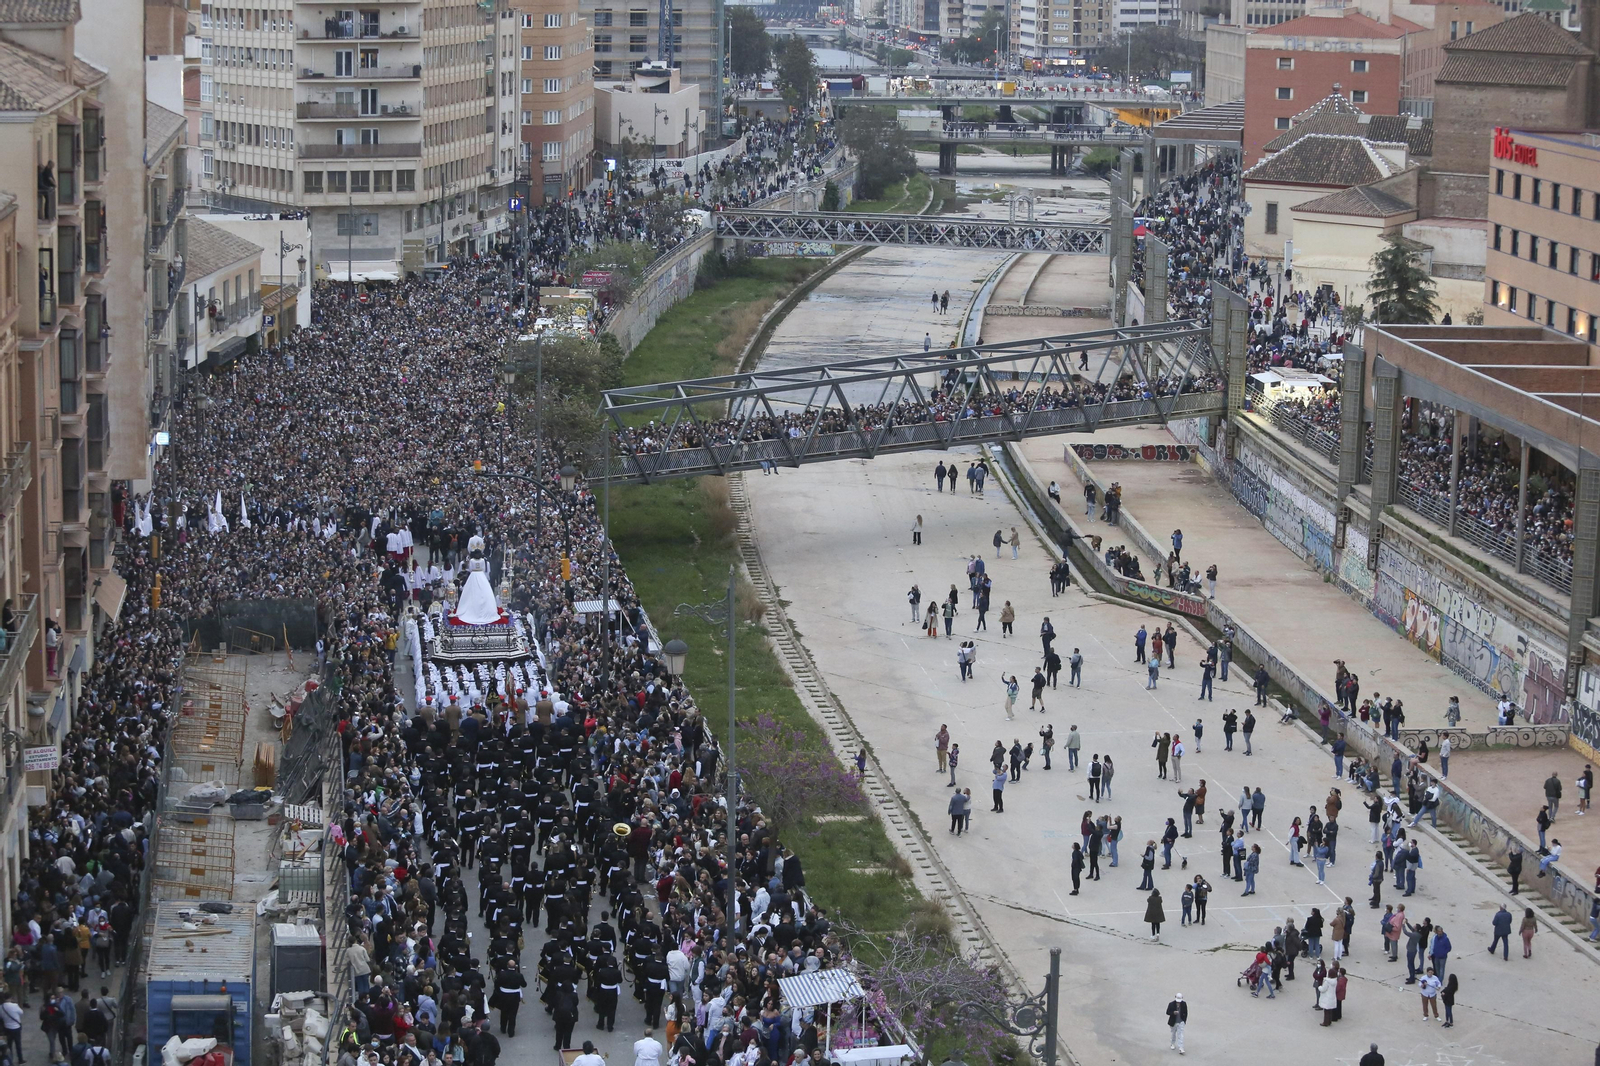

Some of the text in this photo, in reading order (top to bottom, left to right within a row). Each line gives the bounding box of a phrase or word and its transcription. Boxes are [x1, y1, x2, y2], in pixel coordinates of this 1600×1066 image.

[1313, 41, 1363, 53] HOTELS
[1494, 126, 1514, 160] ibis
[511, 198, 519, 209] P
[265, 315, 272, 324] P
